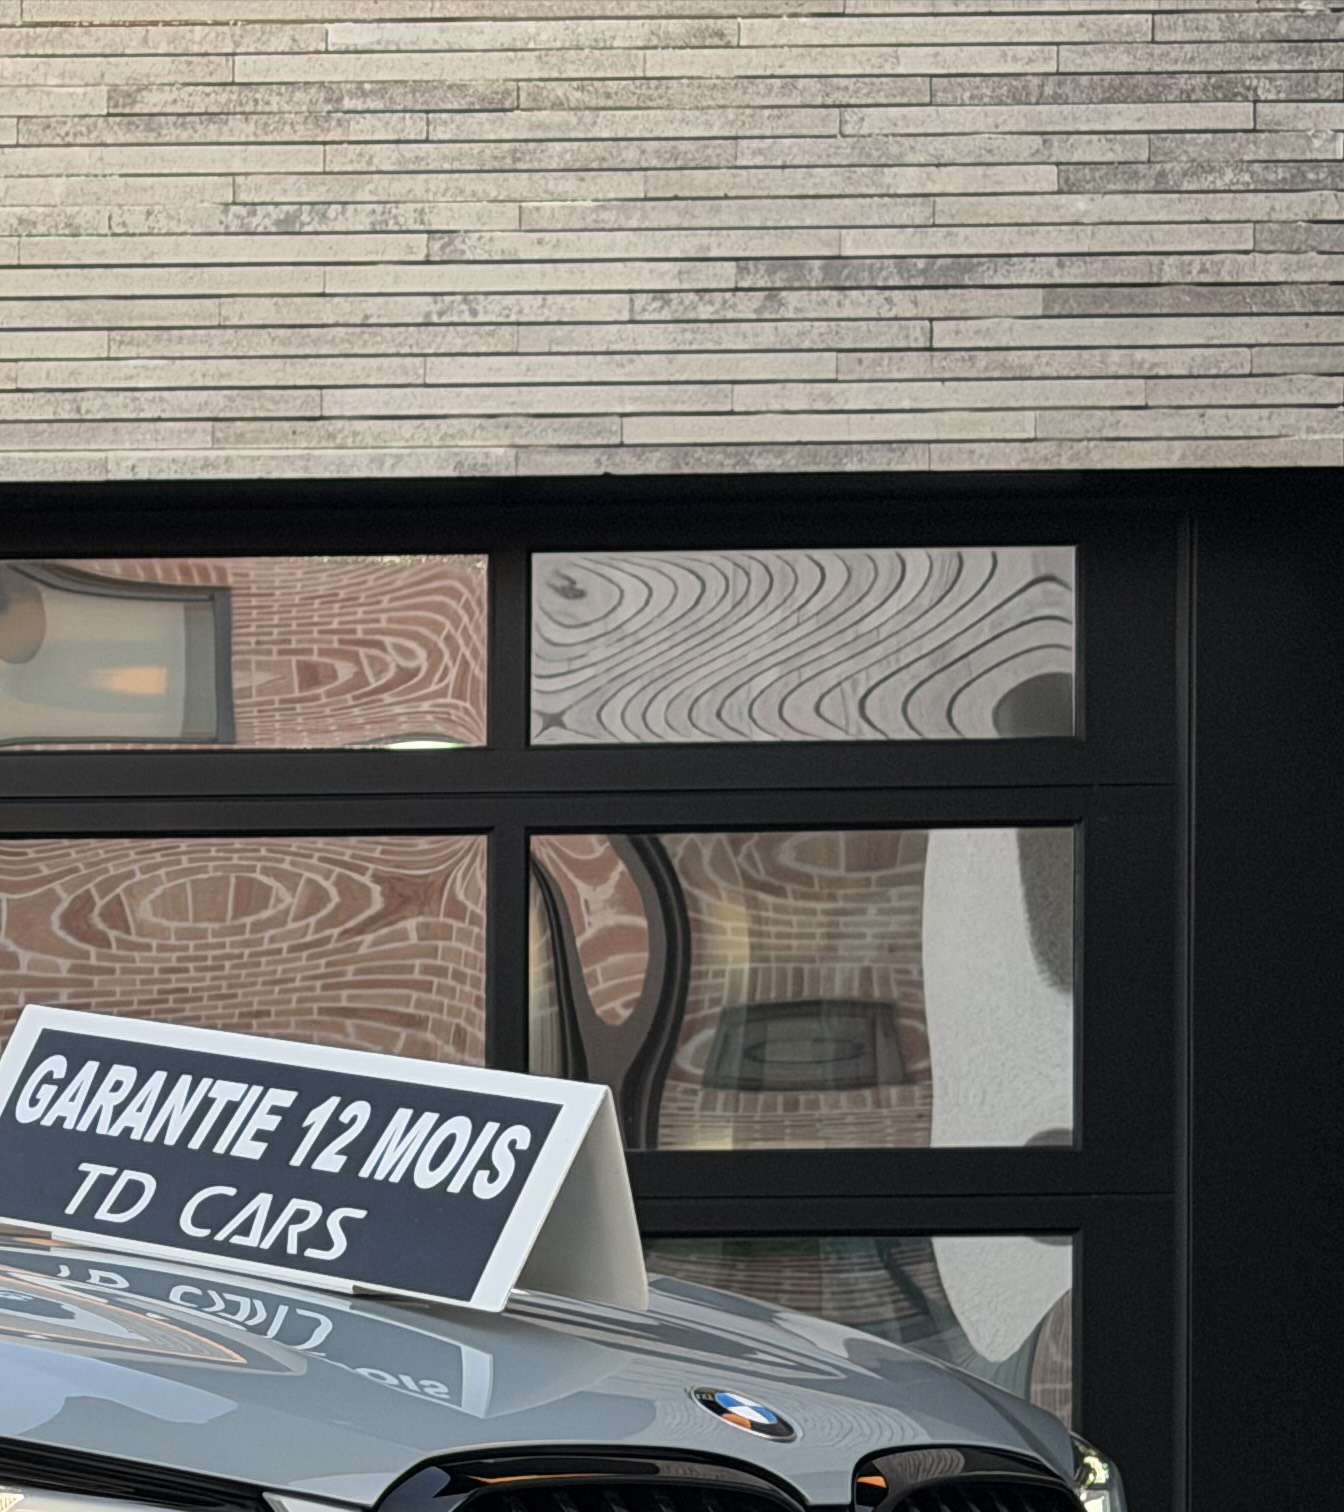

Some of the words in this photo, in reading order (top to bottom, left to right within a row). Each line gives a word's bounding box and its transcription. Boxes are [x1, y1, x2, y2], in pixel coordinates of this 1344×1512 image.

[15, 1054, 299, 1161] GARANTIE
[289, 1095, 372, 1173] 12
[358, 1107, 532, 1200] MOIS
[64, 1162, 157, 1223] TD
[179, 1185, 368, 1261] CARS
